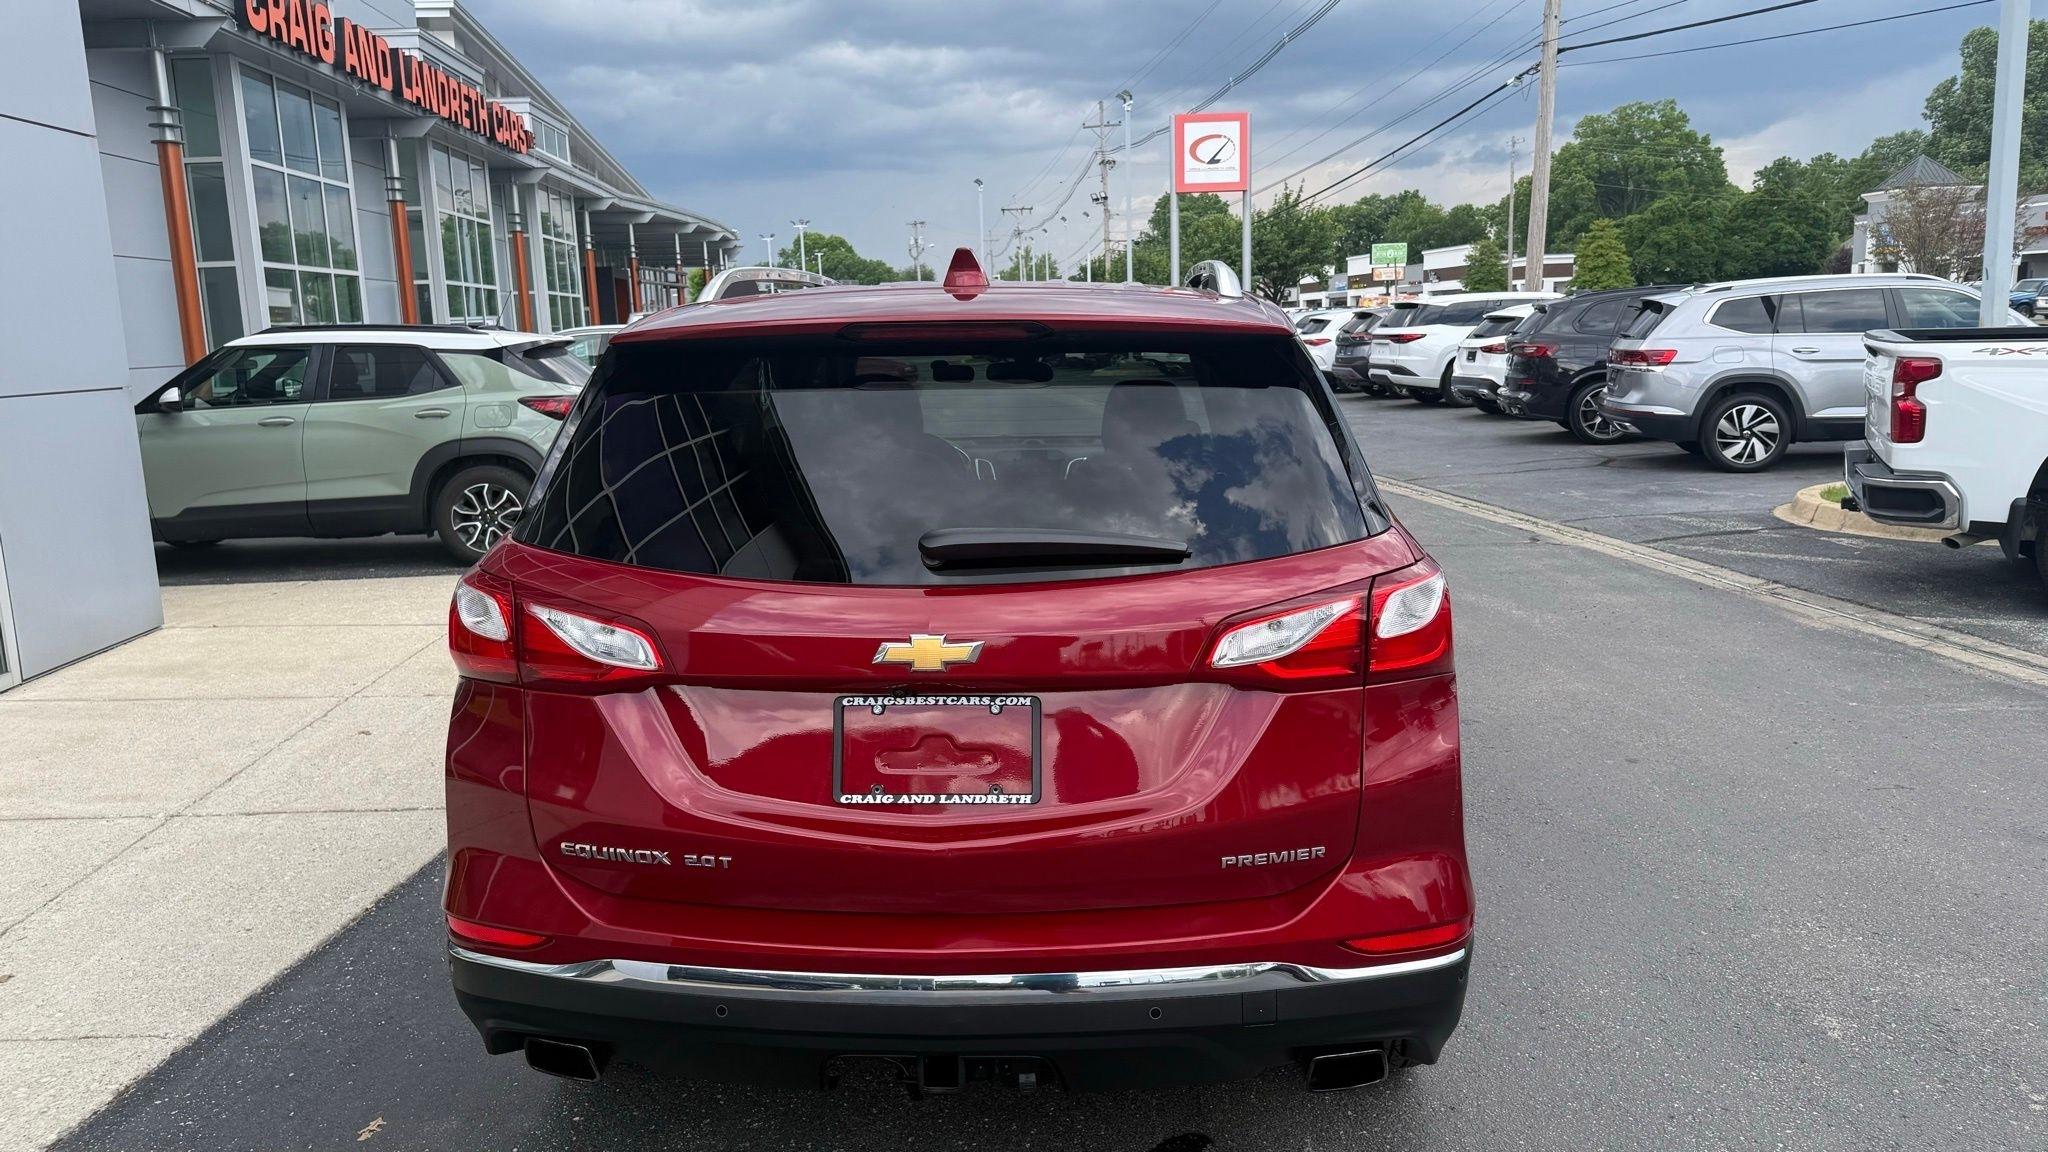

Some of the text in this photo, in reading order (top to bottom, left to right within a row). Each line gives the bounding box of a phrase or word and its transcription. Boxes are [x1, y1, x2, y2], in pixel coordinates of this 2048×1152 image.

[245, 0, 335, 64] CRAIG
[344, 17, 394, 92] AND
[398, 47, 490, 138] LANDRETH
[492, 101, 528, 155] CARS
[842, 696, 1032, 706] CRAIGSBESTCARS.COM
[840, 794, 1033, 804] CRAIG AND LANDRETH
[560, 841, 672, 866] EQUINOX
[1221, 846, 1326, 869] PREMIER
